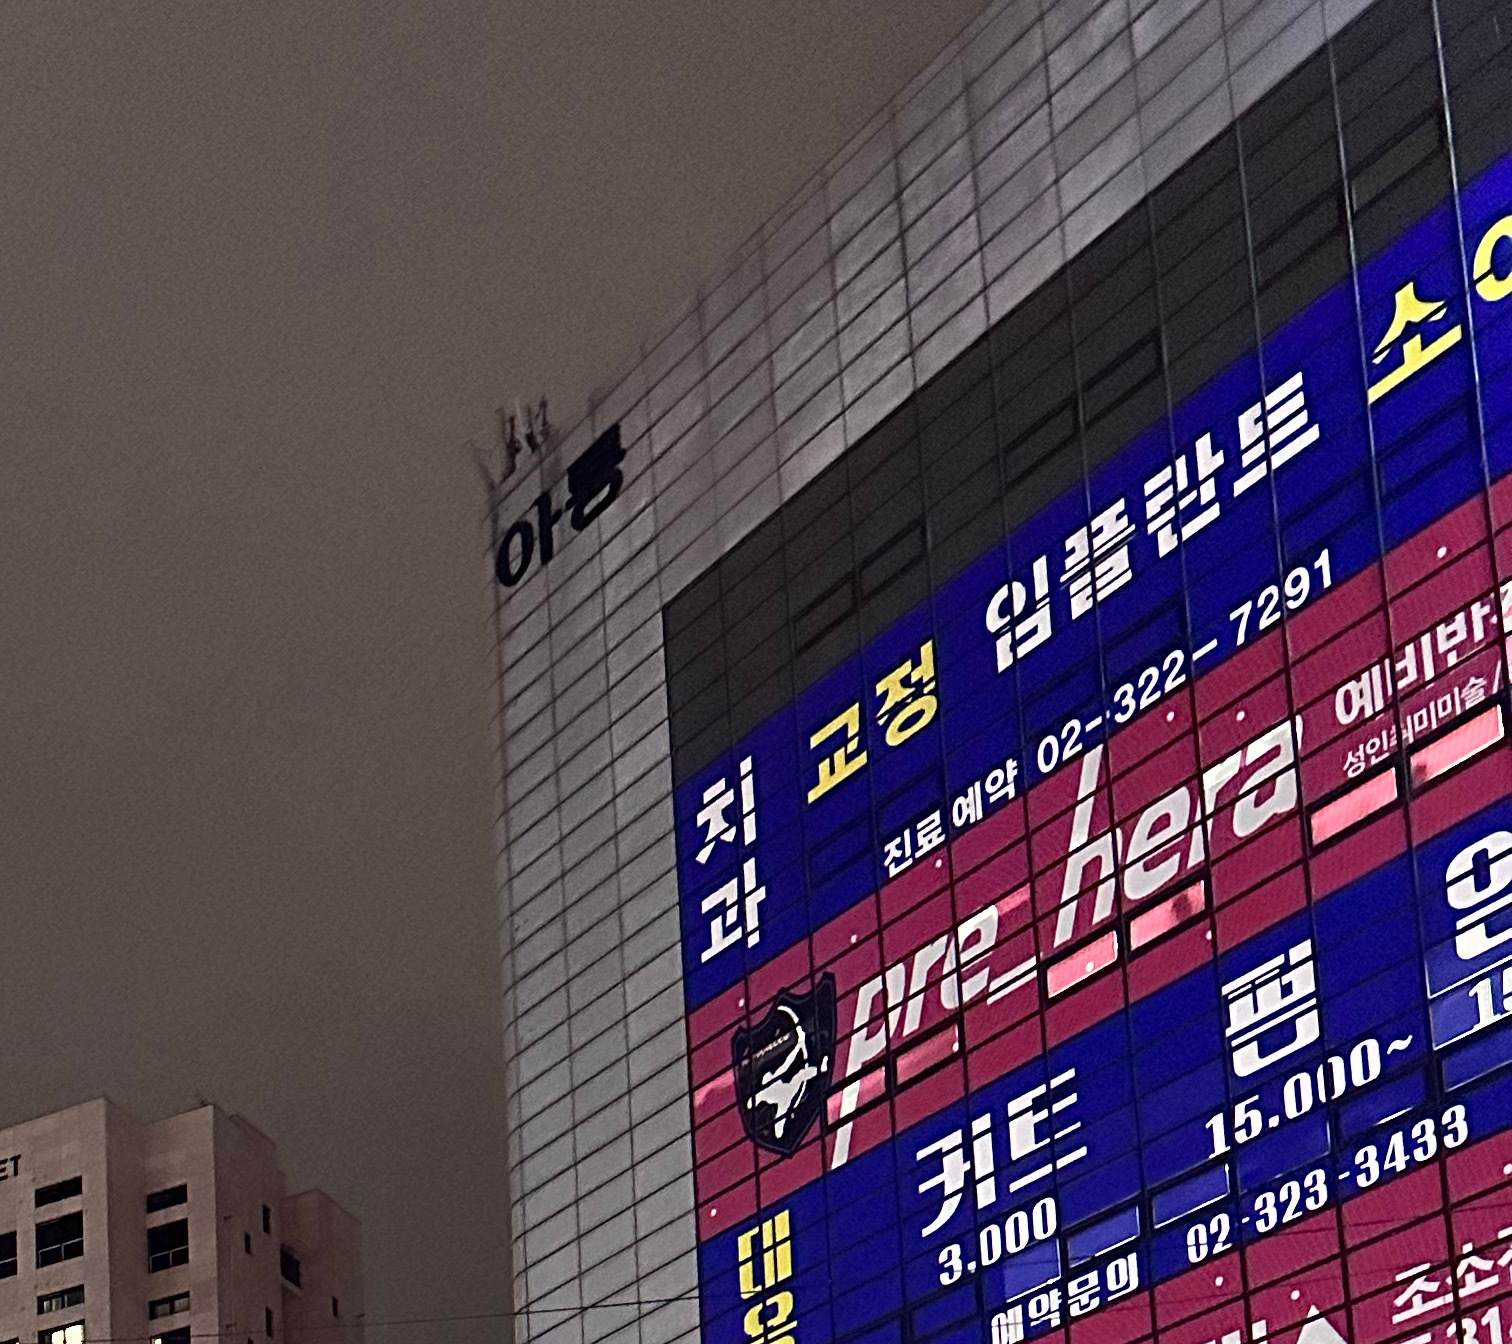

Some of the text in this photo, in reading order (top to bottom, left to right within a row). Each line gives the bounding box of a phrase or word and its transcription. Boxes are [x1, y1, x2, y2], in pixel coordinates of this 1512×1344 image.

[986, 371, 1320, 673] 임플란트
[807, 638, 938, 806] 교정
[695, 755, 767, 964] 치과
[884, 759, 1019, 879] 진료 예약
[1221, 938, 1321, 1078] 펌
[916, 1068, 1088, 1239] 커트
[1205, 1034, 1413, 1160] 15.000~
[938, 1196, 1059, 1287] 3.000
[1186, 1104, 1469, 1265] 02-323-3433
